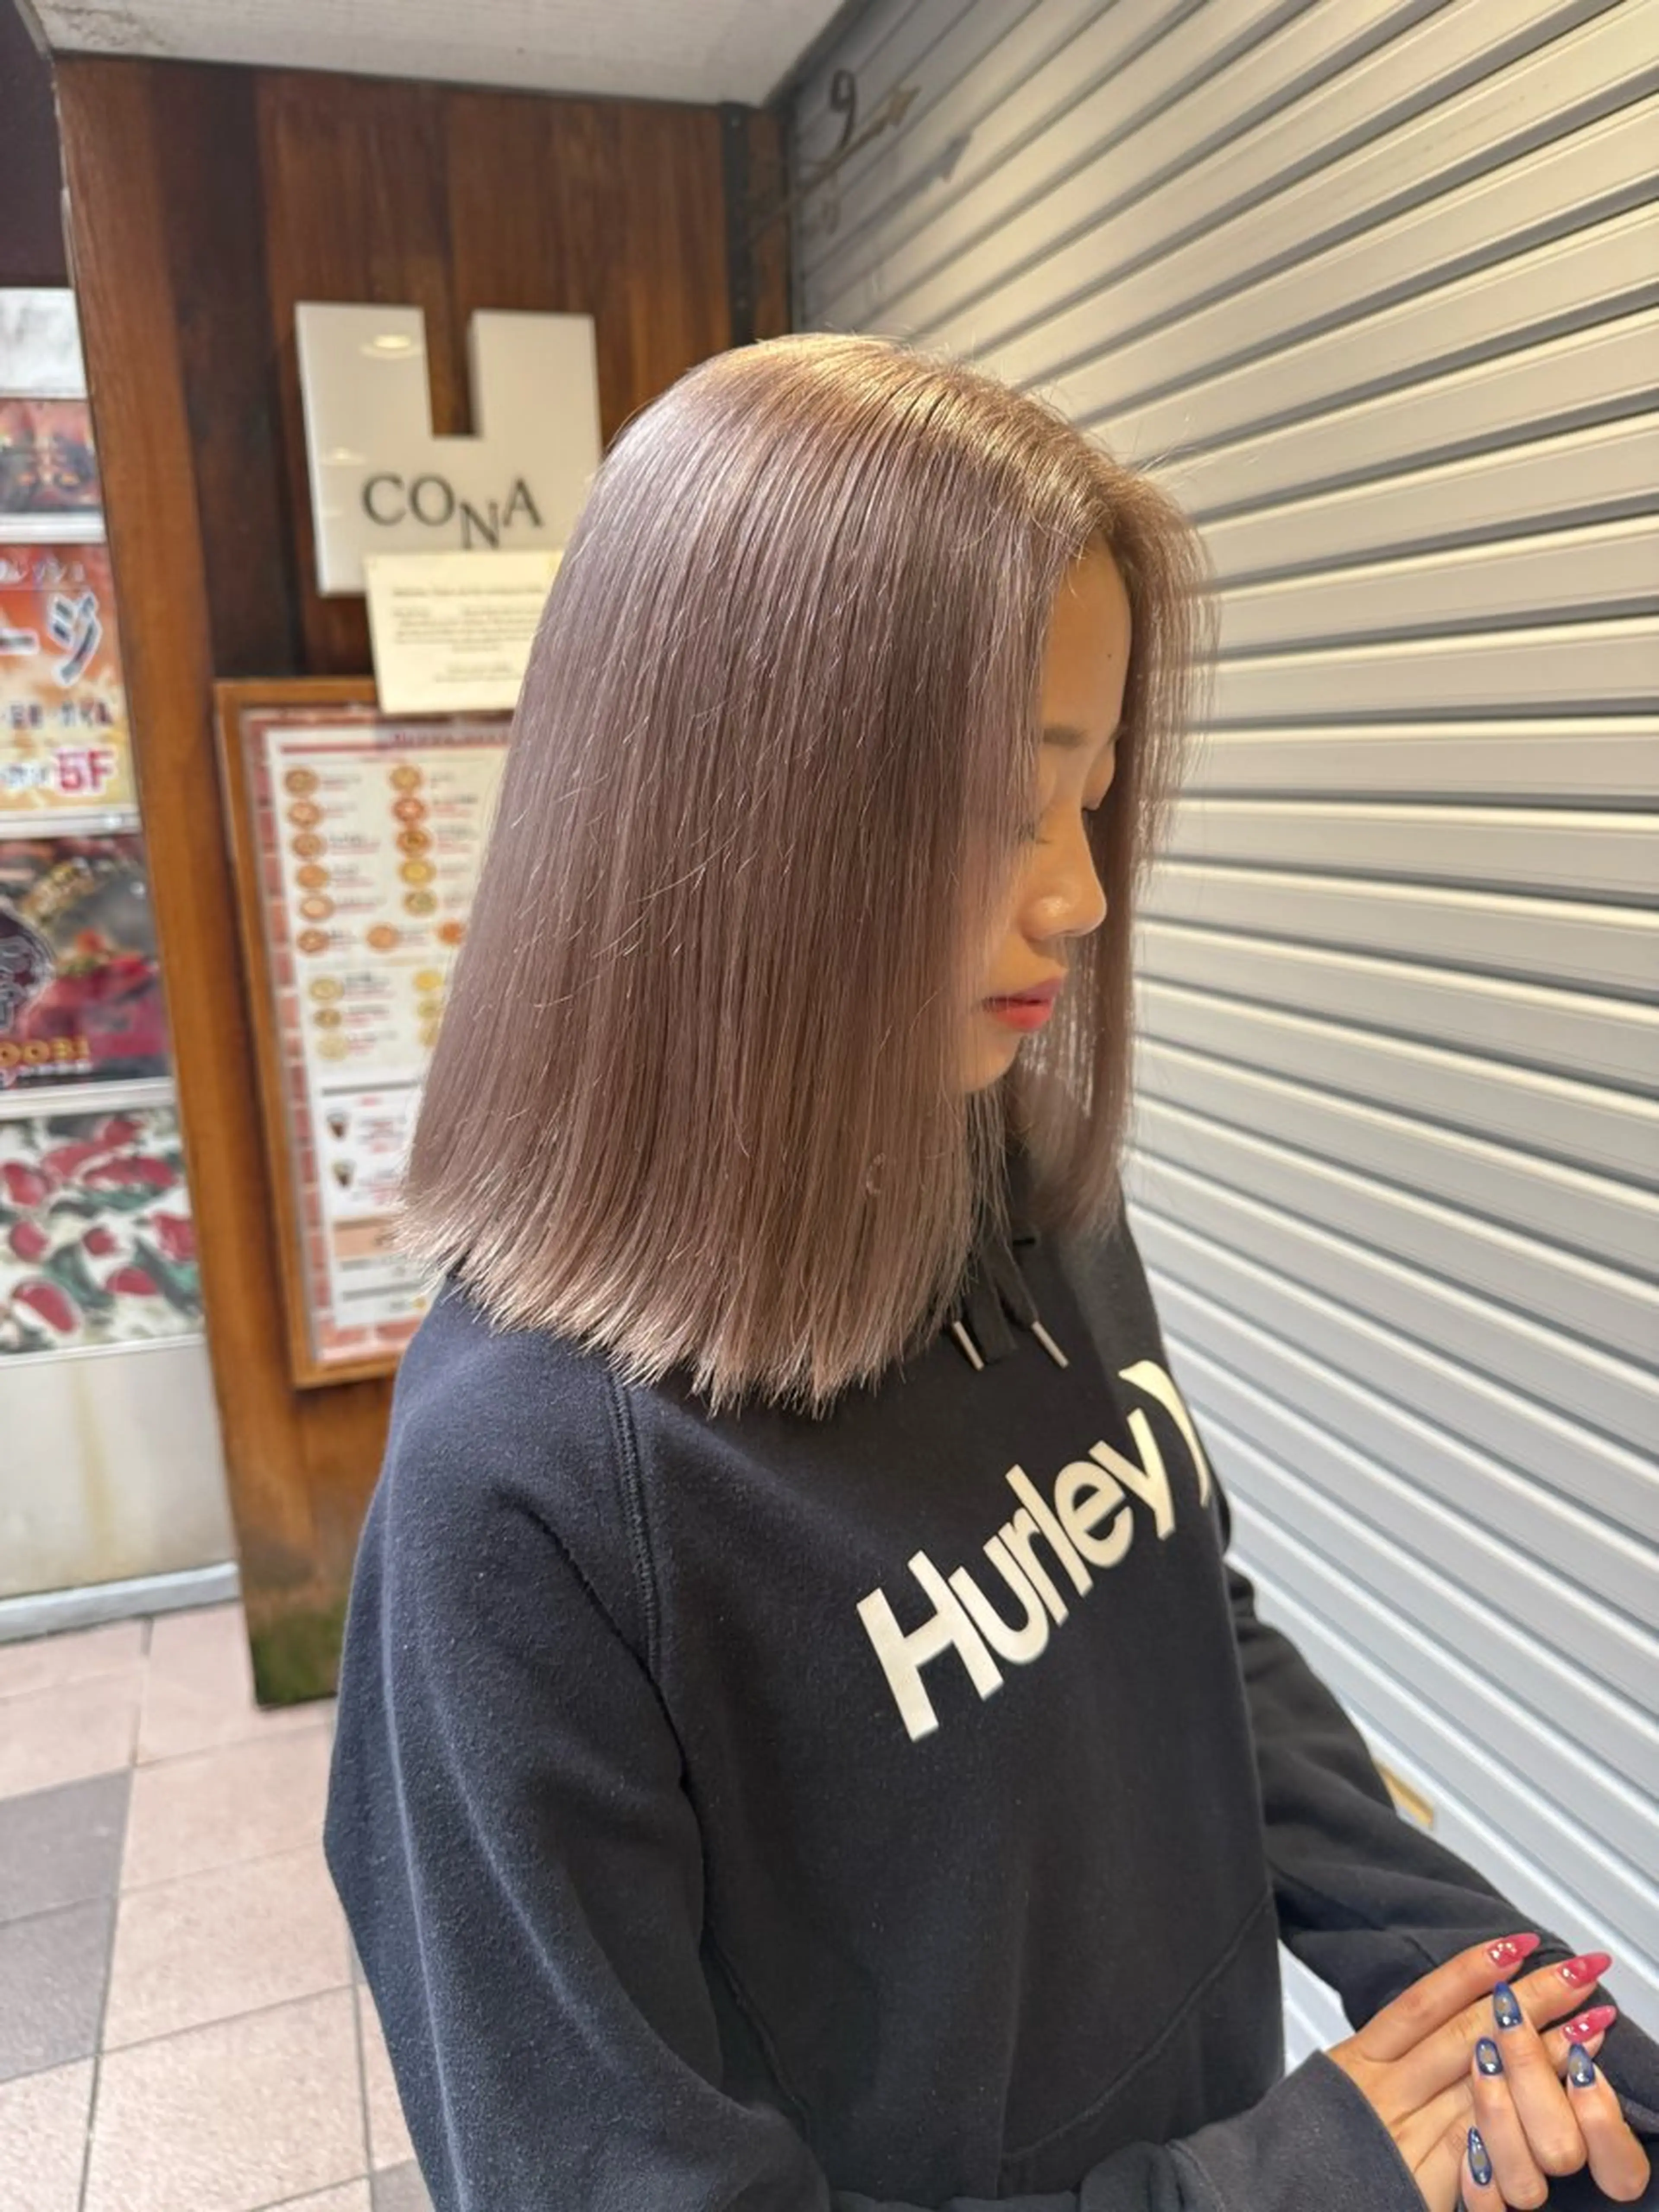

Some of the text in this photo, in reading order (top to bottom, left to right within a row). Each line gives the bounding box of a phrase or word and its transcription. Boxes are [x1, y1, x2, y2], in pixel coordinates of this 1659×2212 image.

[362, 472, 544, 550] CONA
[57, 748, 115, 791] 5F
[856, 1407, 1176, 1742] Hurley
